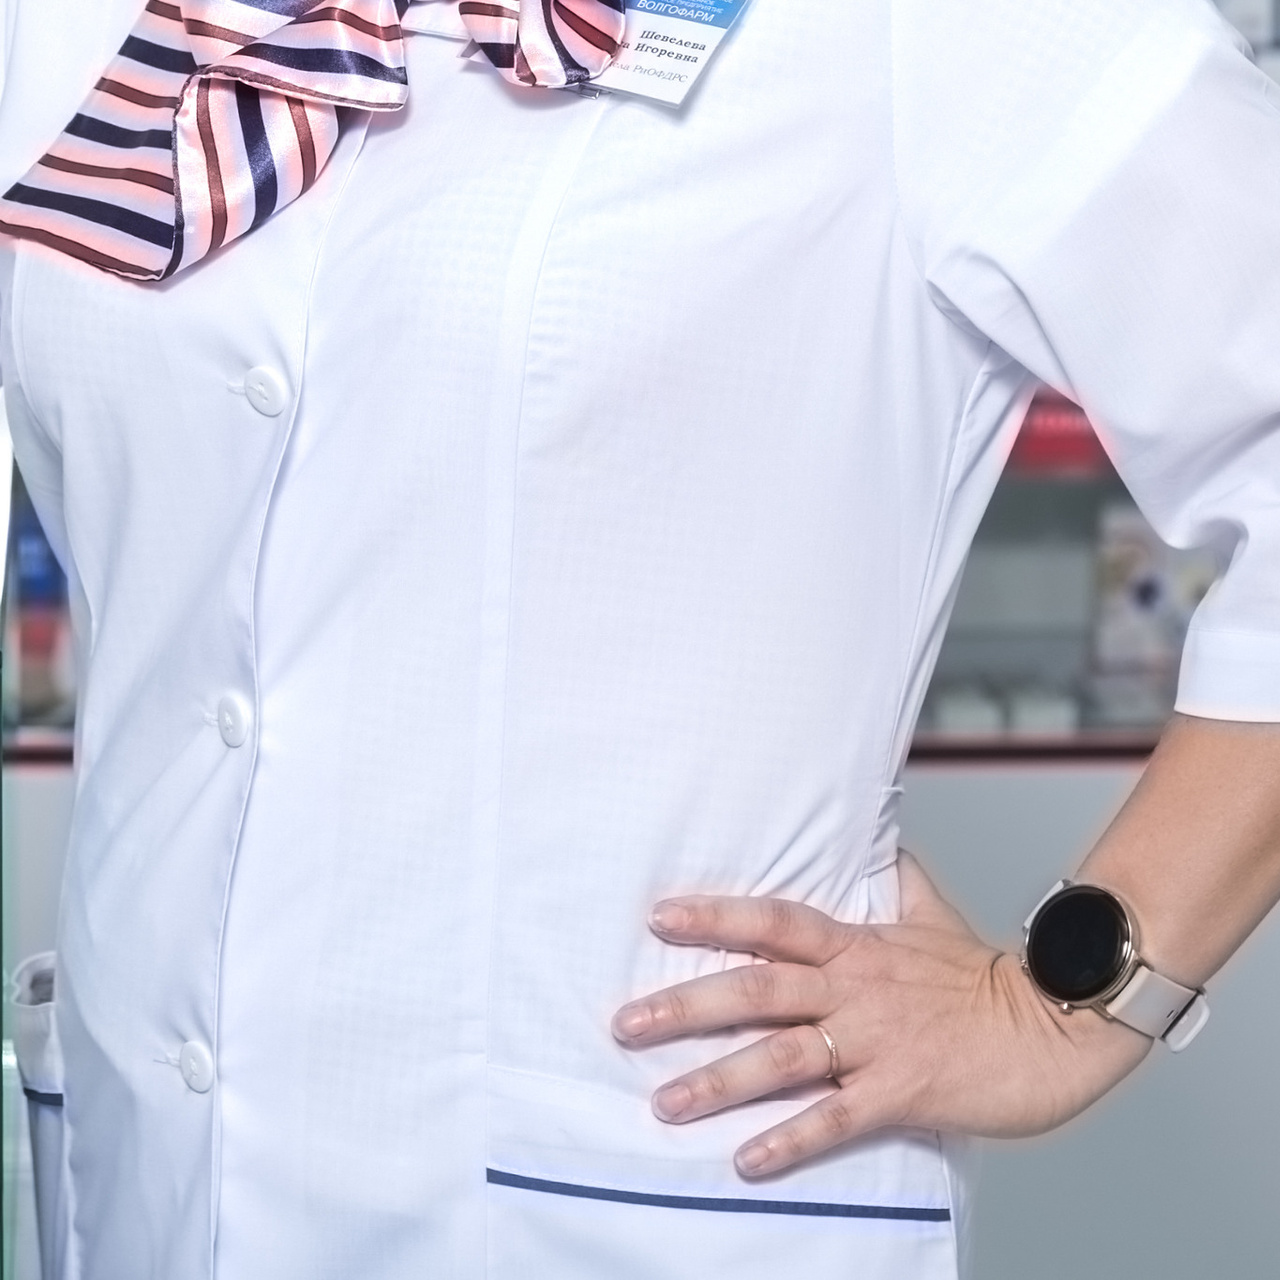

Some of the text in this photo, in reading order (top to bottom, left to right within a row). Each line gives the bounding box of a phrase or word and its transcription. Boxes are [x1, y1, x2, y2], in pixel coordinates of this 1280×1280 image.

[676, 0, 725, 14] ПРЕДПРИЯТИЕ
[639, 30, 707, 51] Шевелева
[634, 42, 699, 64] Игоревна
